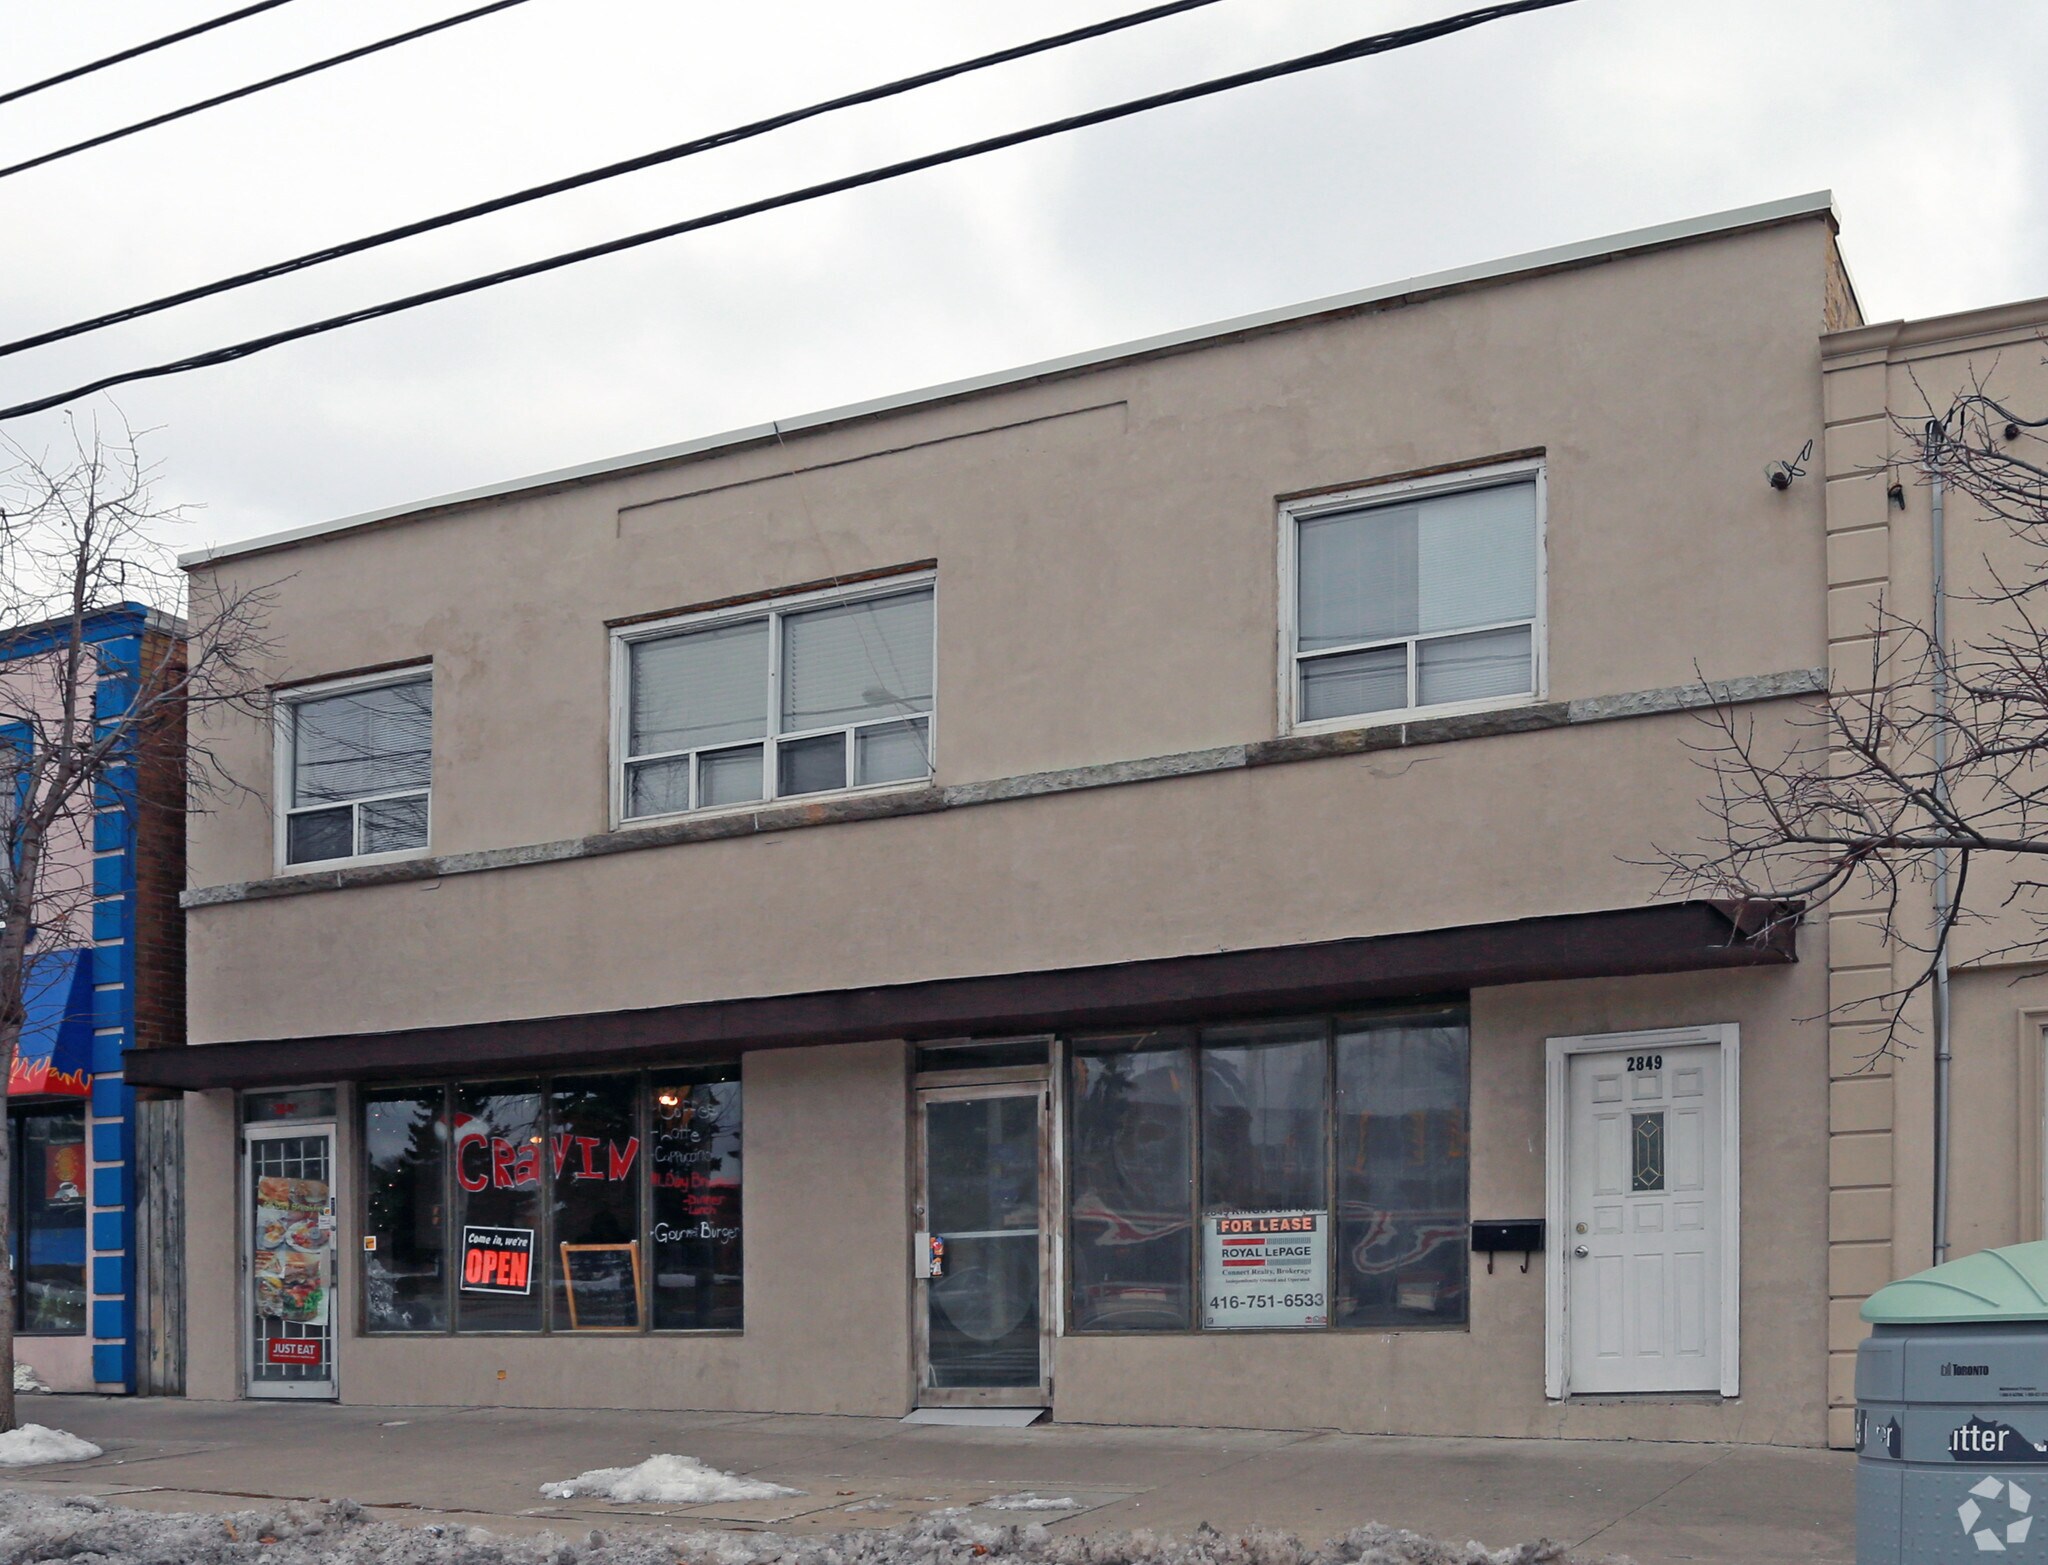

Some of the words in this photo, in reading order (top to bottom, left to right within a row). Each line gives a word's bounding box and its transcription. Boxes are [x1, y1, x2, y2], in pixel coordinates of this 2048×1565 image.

[1627, 1055, 1663, 1072] 2849
[701, 1221, 740, 1244] Burger
[1221, 1219, 1253, 1233] FOR
[1259, 1217, 1312, 1232] LEASE
[468, 1233, 491, 1244] Come
[492, 1235, 503, 1246] in,
[505, 1237, 528, 1247] we're
[1222, 1248, 1262, 1258] ROYAL
[465, 1248, 528, 1287] OPEN
[1276, 1267, 1312, 1275] Brokerage
[1210, 1293, 1324, 1309] 416-751-6533
[273, 1343, 296, 1353] JUST
[297, 1344, 315, 1354] EAT
[1952, 1364, 1989, 1376] TORONTO
[1947, 1425, 2010, 1452] itter
